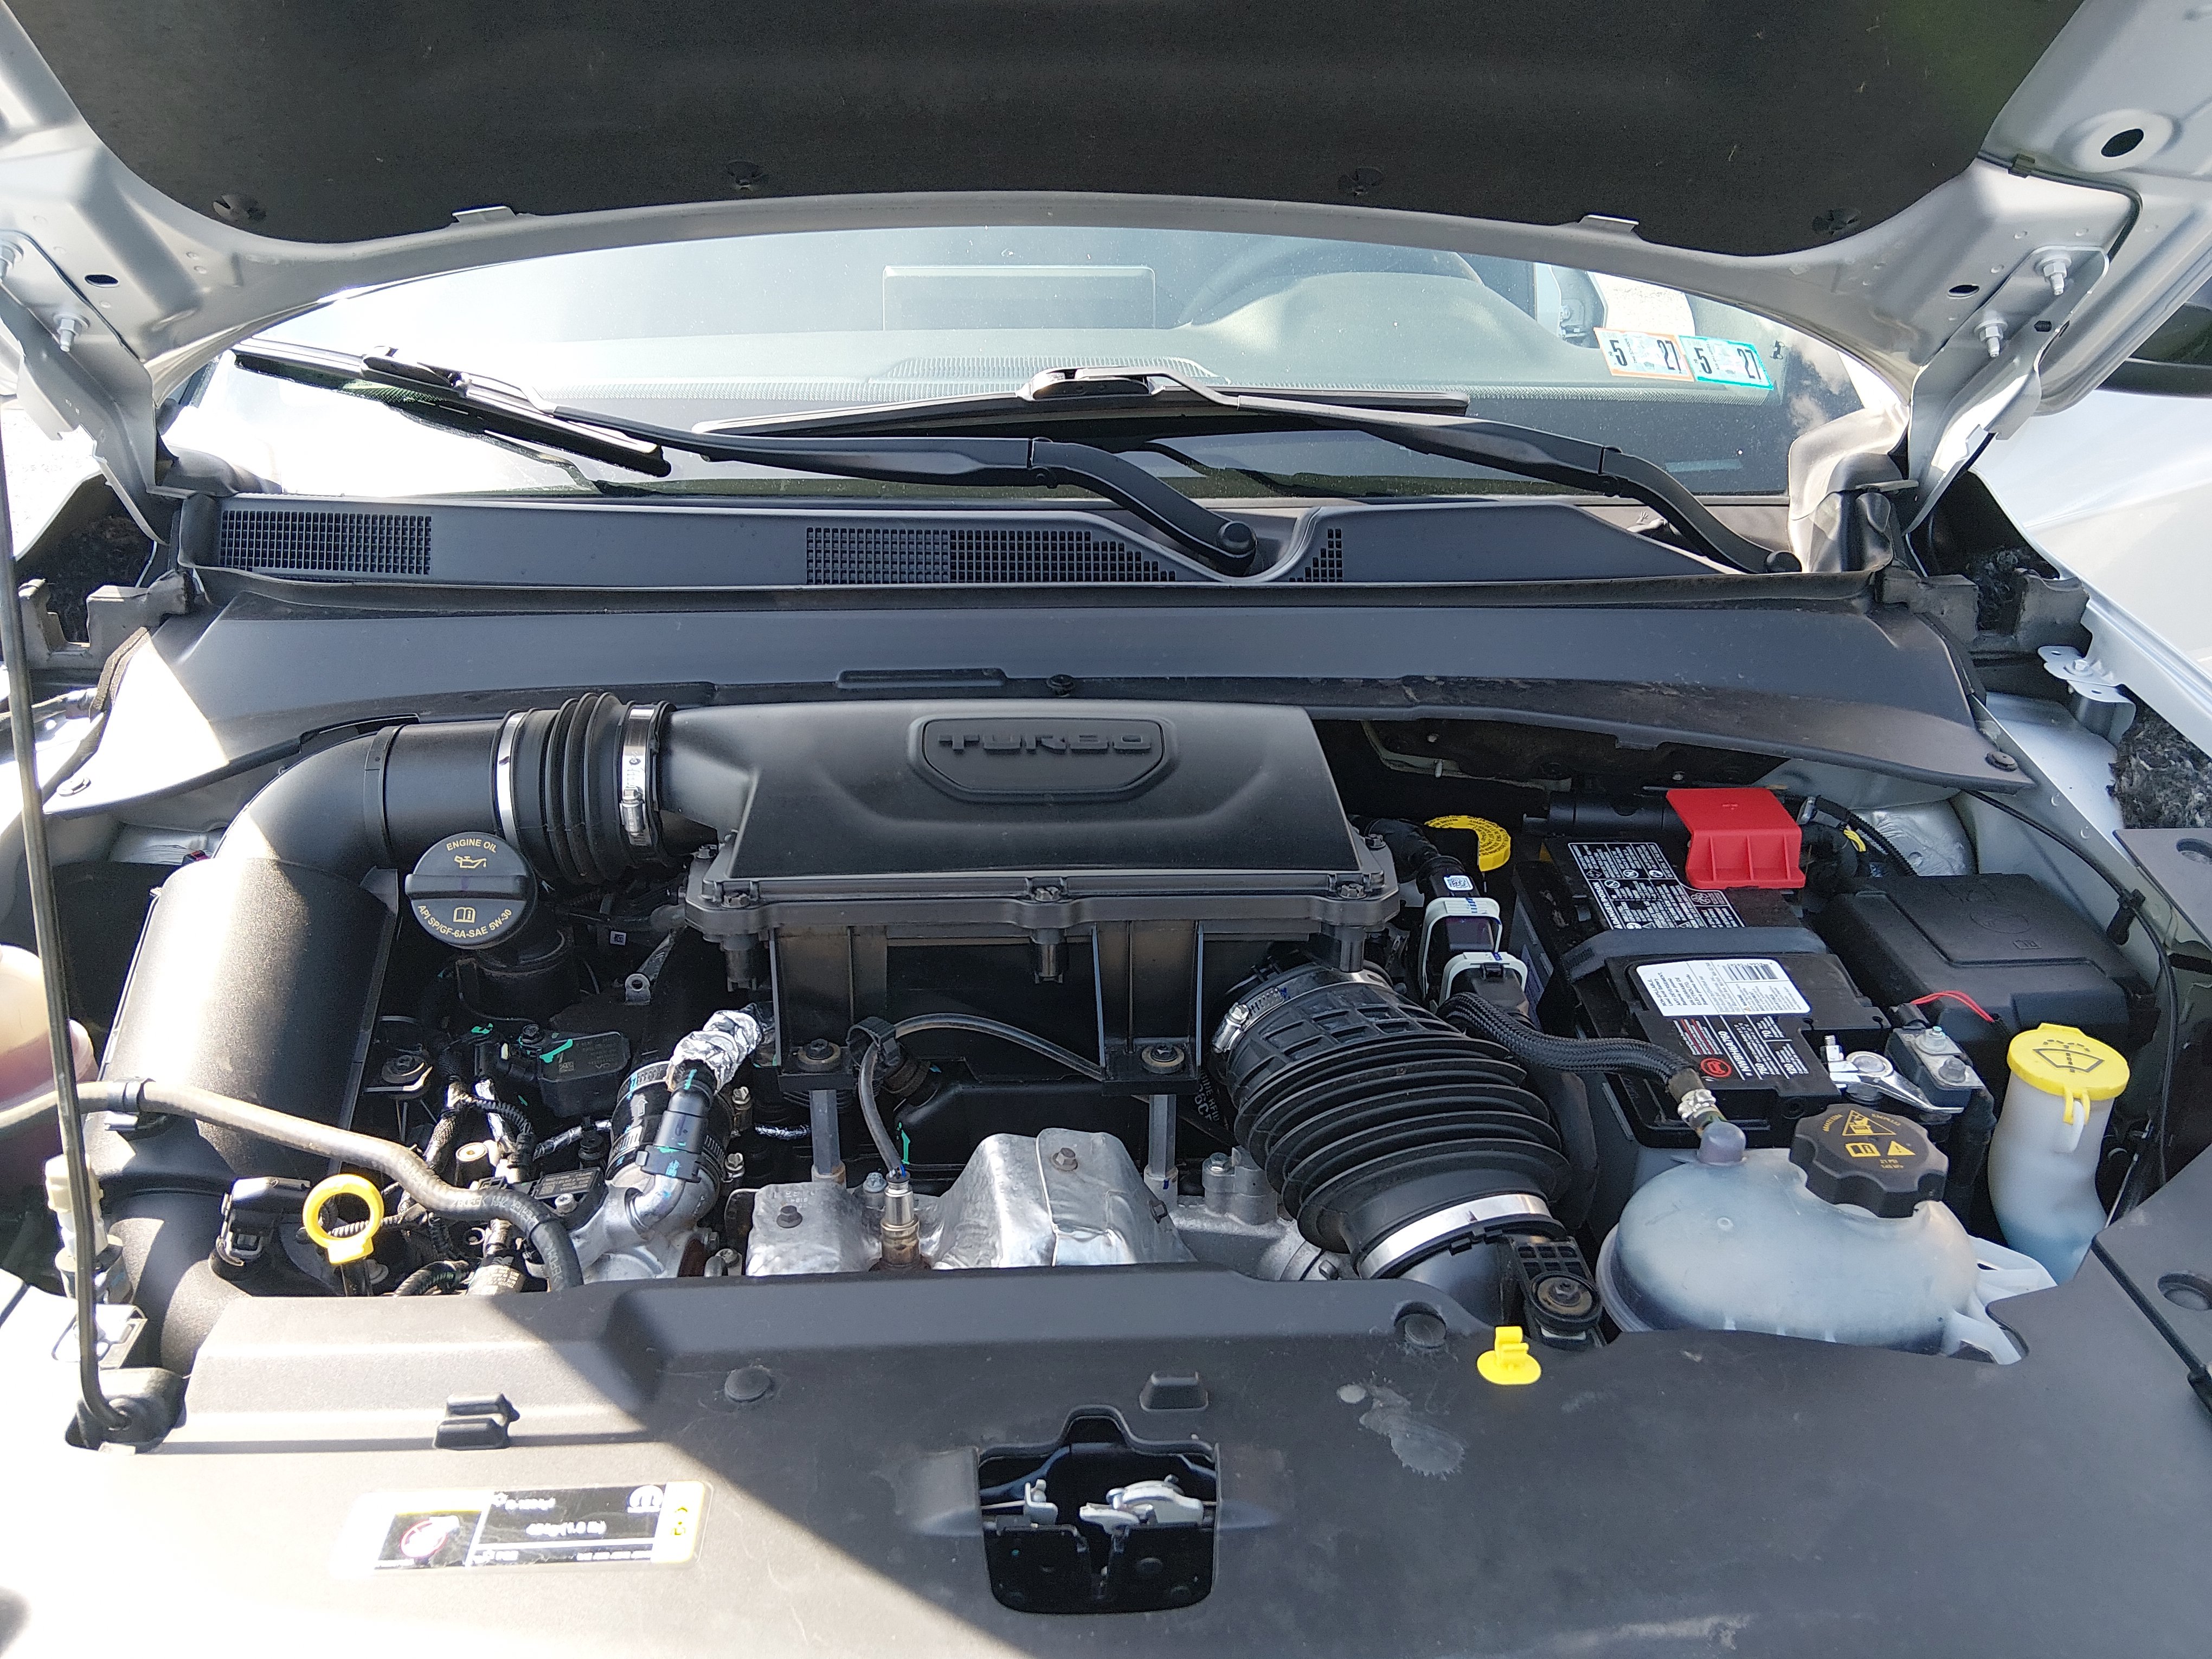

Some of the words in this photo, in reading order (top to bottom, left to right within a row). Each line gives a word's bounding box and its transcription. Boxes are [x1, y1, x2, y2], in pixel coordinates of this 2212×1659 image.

[1609, 339, 1628, 366] 5
[1657, 339, 1681, 372] 27
[1694, 347, 1712, 374] 5
[1737, 348, 1761, 381] 27
[938, 733, 1152, 755] TURBO
[446, 839, 481, 851] ENGINE
[483, 841, 497, 853] OIL
[1591, 882, 1621, 924] DANGER/POISON
[418, 905, 430, 919] API
[489, 908, 512, 931] 5W-30
[1753, 1063, 1770, 1075] 760
[1782, 1063, 1799, 1074] 120
